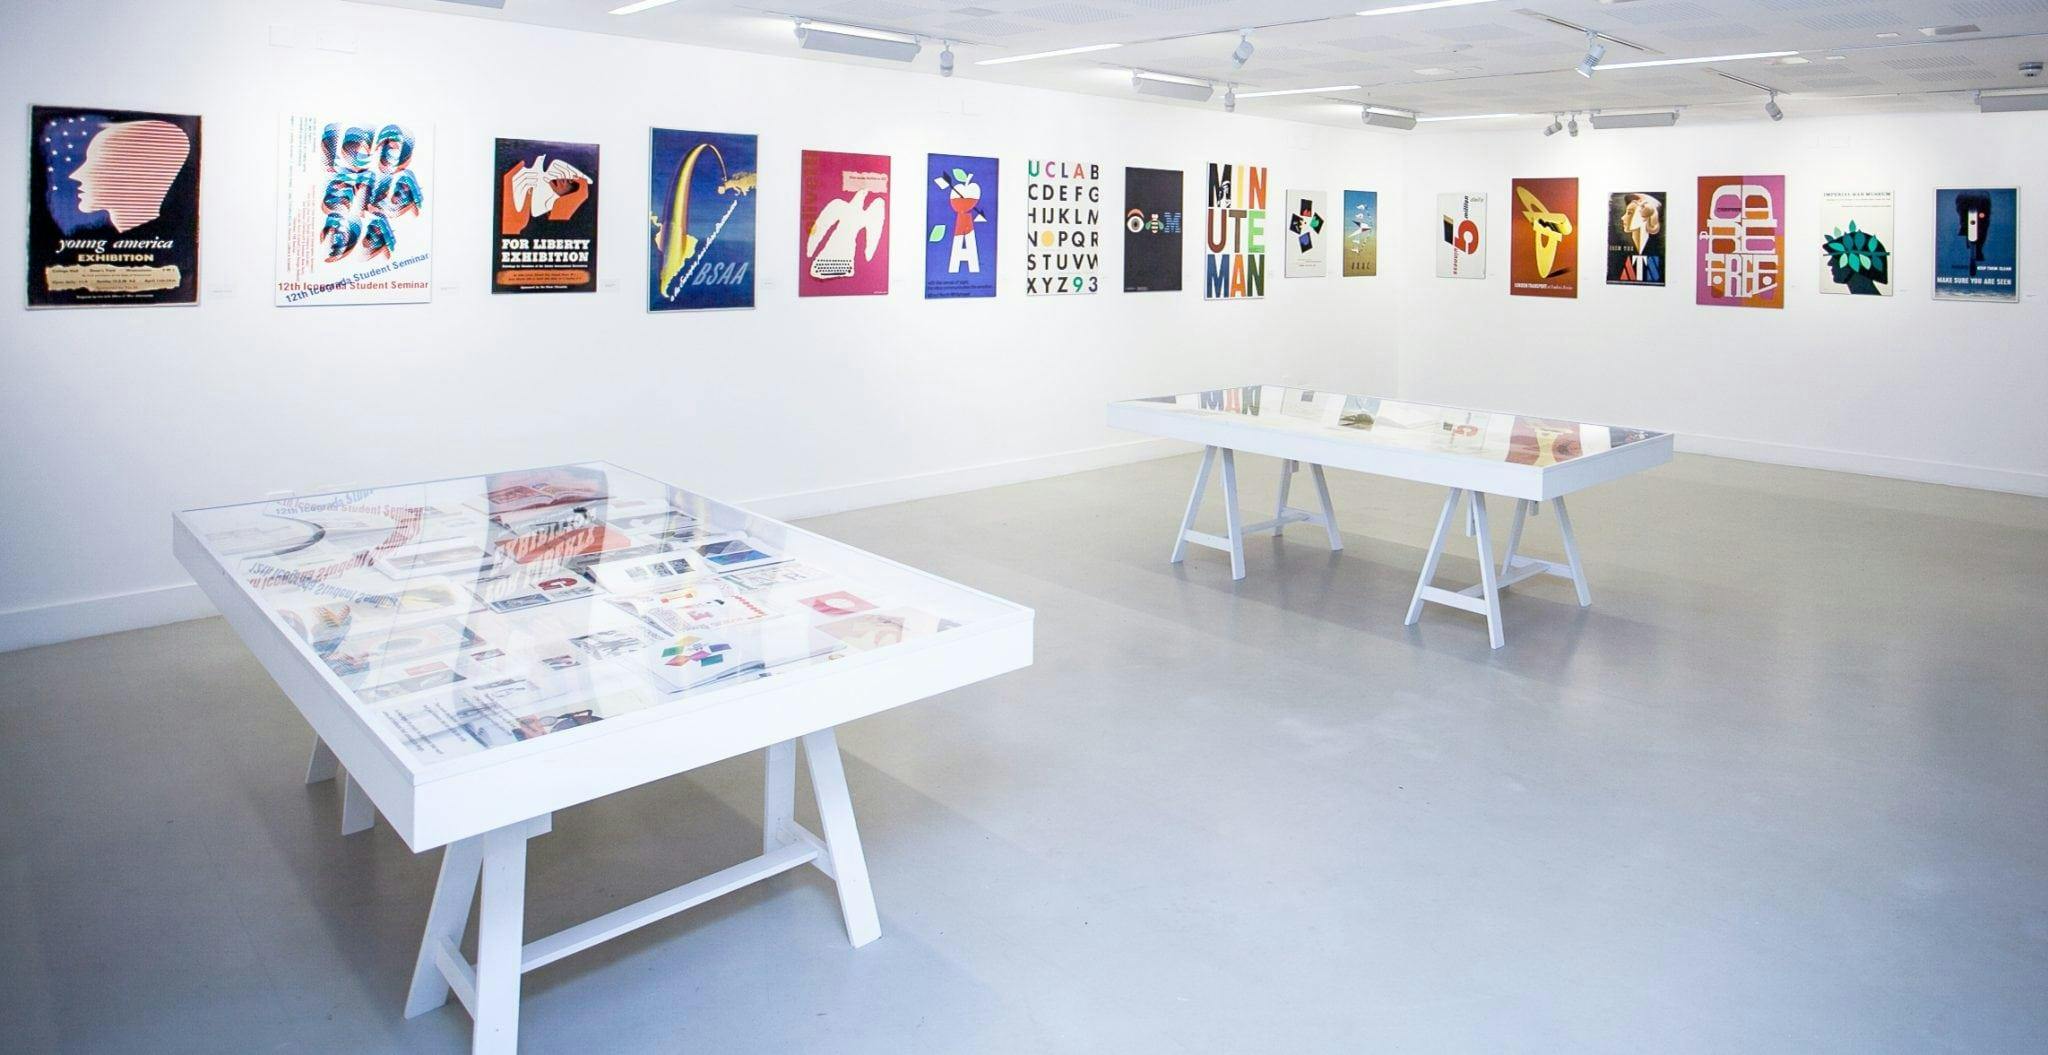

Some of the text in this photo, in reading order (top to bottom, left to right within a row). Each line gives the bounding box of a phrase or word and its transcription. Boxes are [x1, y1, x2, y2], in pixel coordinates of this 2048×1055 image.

[1208, 162, 1267, 210] MIN
[1207, 209, 1266, 253] UTE
[56, 236, 174, 253] young america
[502, 239, 590, 250] FOR LIBERTY
[78, 253, 154, 262] EXHIBITION
[502, 252, 589, 262] EXHIBITION
[285, 290, 308, 303] 12th
[353, 265, 391, 282] Student
[393, 252, 429, 270] Seminar
[693, 261, 749, 286] BSAA
[1206, 254, 1265, 298] MAN
[278, 282, 300, 291] 12th
[350, 281, 388, 290] Student
[392, 281, 429, 289] Seminar
